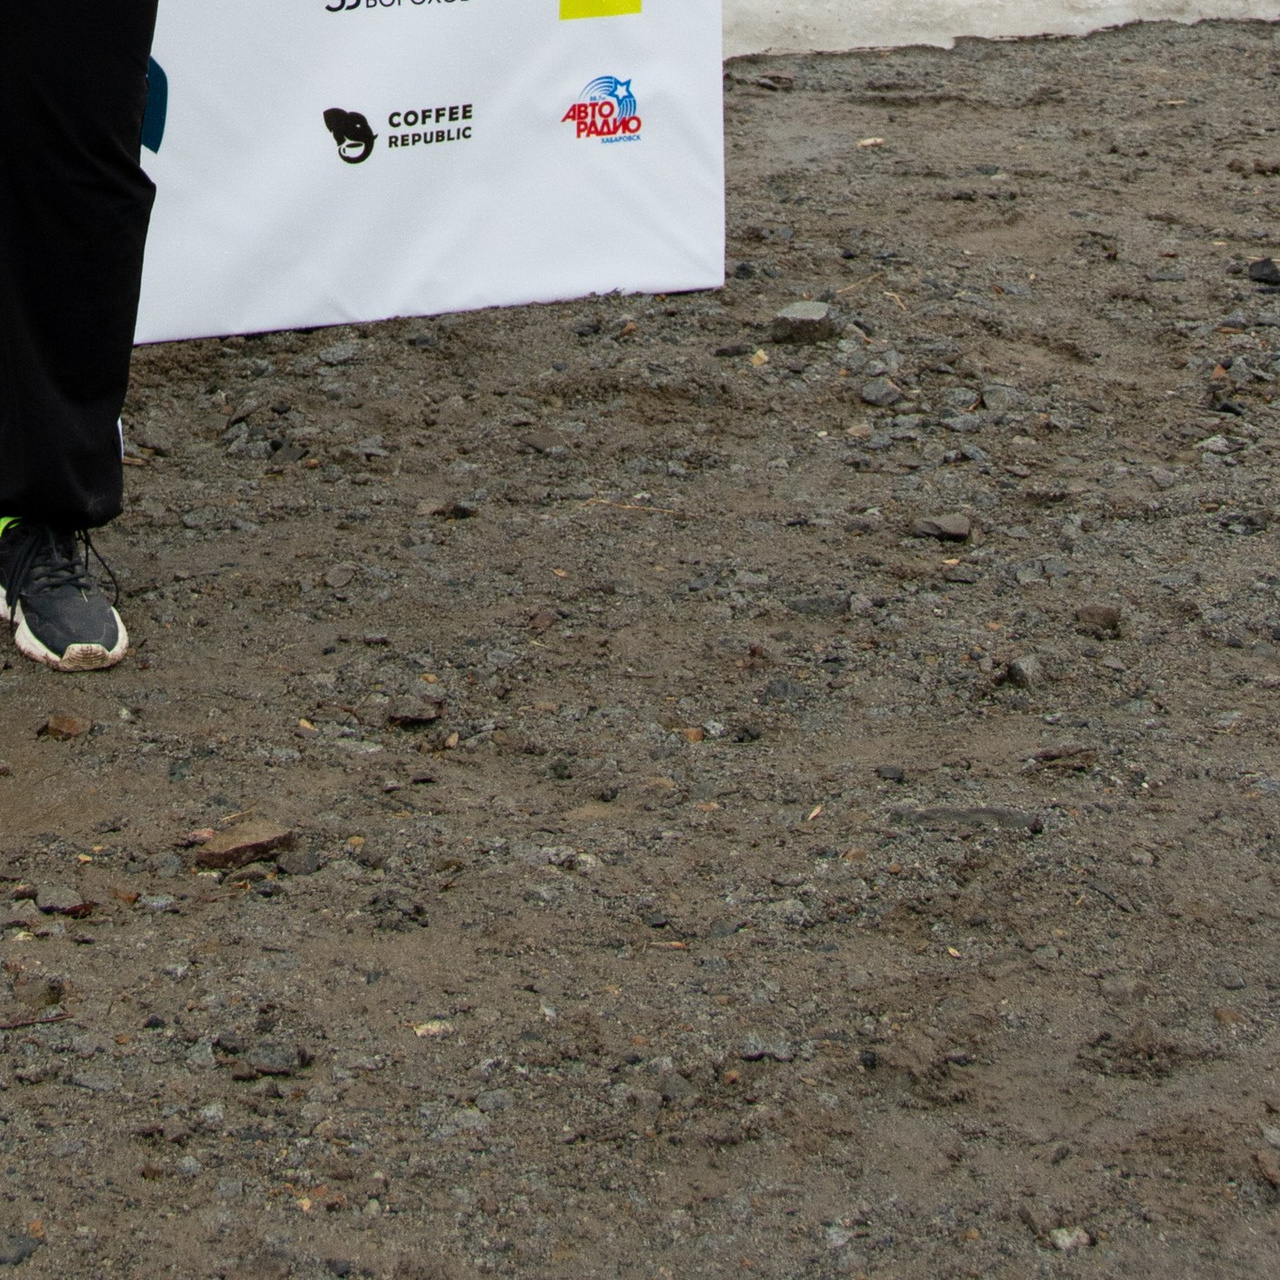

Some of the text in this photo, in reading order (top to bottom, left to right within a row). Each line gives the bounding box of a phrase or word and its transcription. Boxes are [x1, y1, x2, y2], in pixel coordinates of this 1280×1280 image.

[388, 104, 472, 128] COFFEE
[561, 101, 614, 123] АВТО
[388, 126, 472, 148] REPUBLIC
[577, 116, 641, 138] РАДИО
